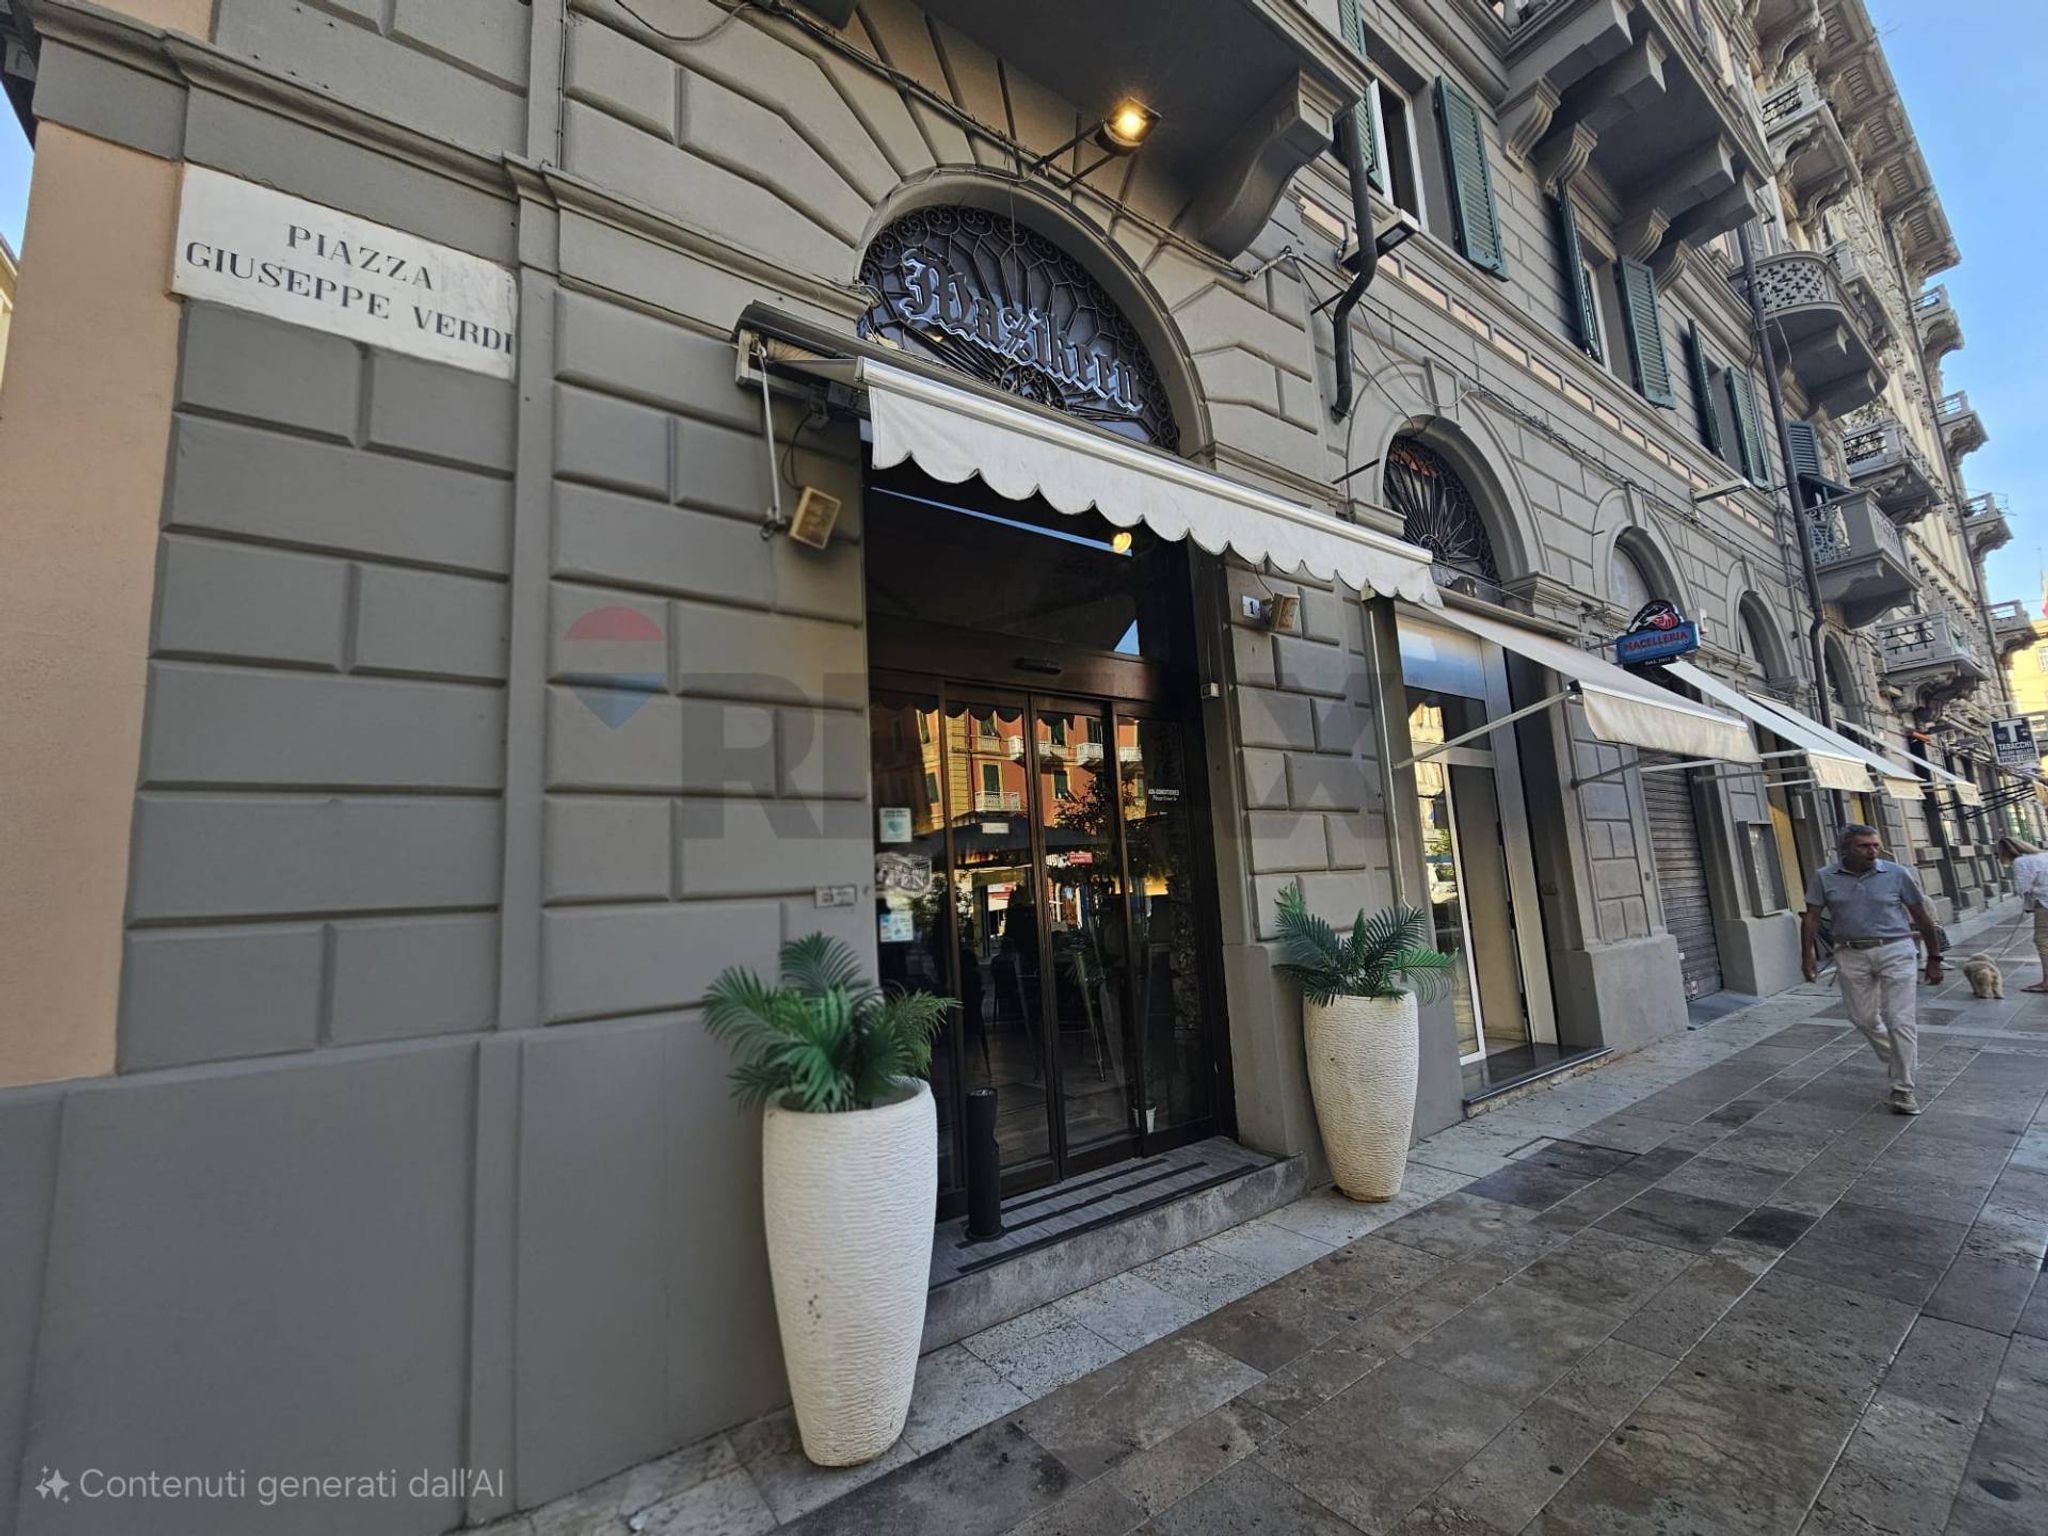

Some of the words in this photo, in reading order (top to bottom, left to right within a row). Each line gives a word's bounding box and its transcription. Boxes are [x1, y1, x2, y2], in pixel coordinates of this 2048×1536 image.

[286, 224, 433, 291] PIAZZA
[186, 241, 390, 320] GIUSEPPE
[411, 305, 513, 354] VERDI
[1625, 632, 1688, 651] MACELLERIA
[1998, 720, 2023, 742] T
[1998, 741, 2033, 751] TABACCHI
